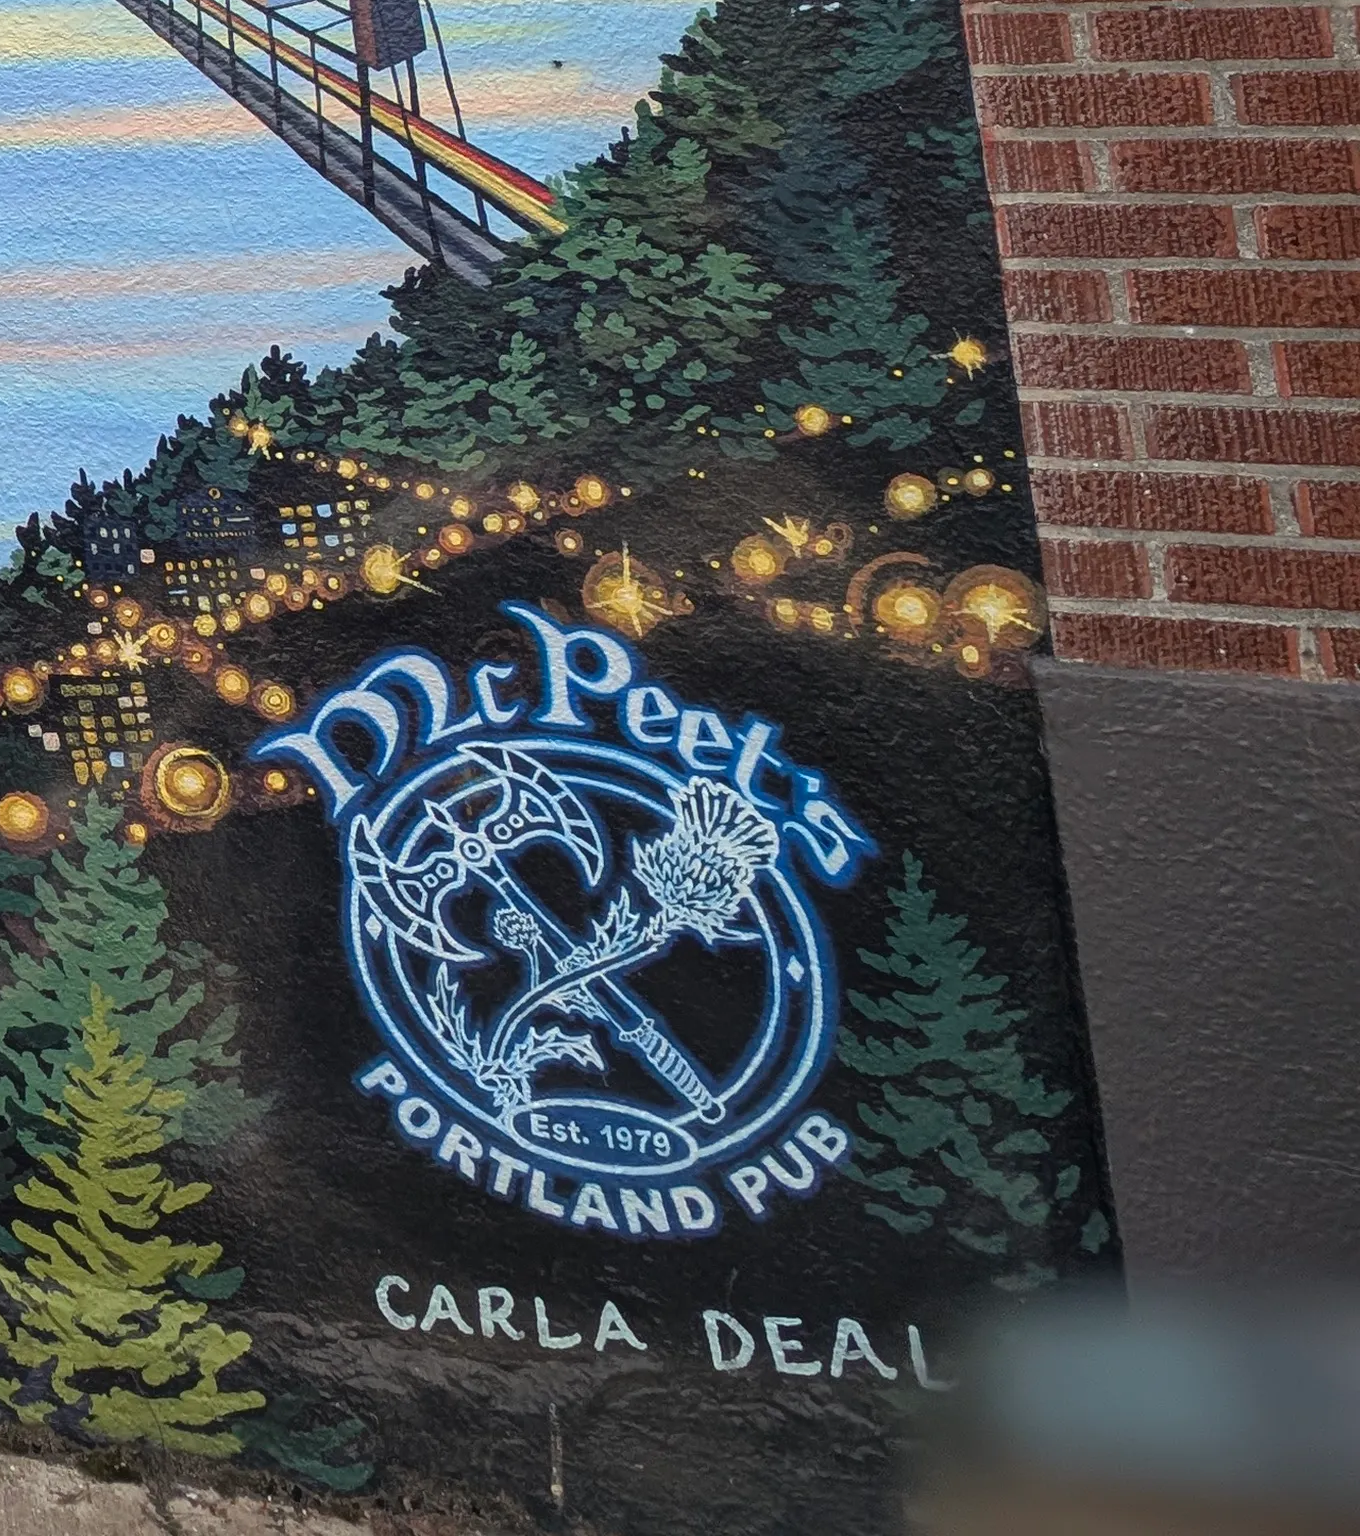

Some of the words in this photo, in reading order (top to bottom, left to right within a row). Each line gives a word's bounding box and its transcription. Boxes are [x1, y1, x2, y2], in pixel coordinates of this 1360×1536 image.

[358, 1060, 718, 1235] PORTLAND
[729, 1114, 849, 1215] PUB
[529, 1114, 590, 1147] Est.
[599, 1124, 672, 1158] 1979
[374, 1274, 648, 1353] CARLA
[702, 1308, 958, 1391] DEAL
